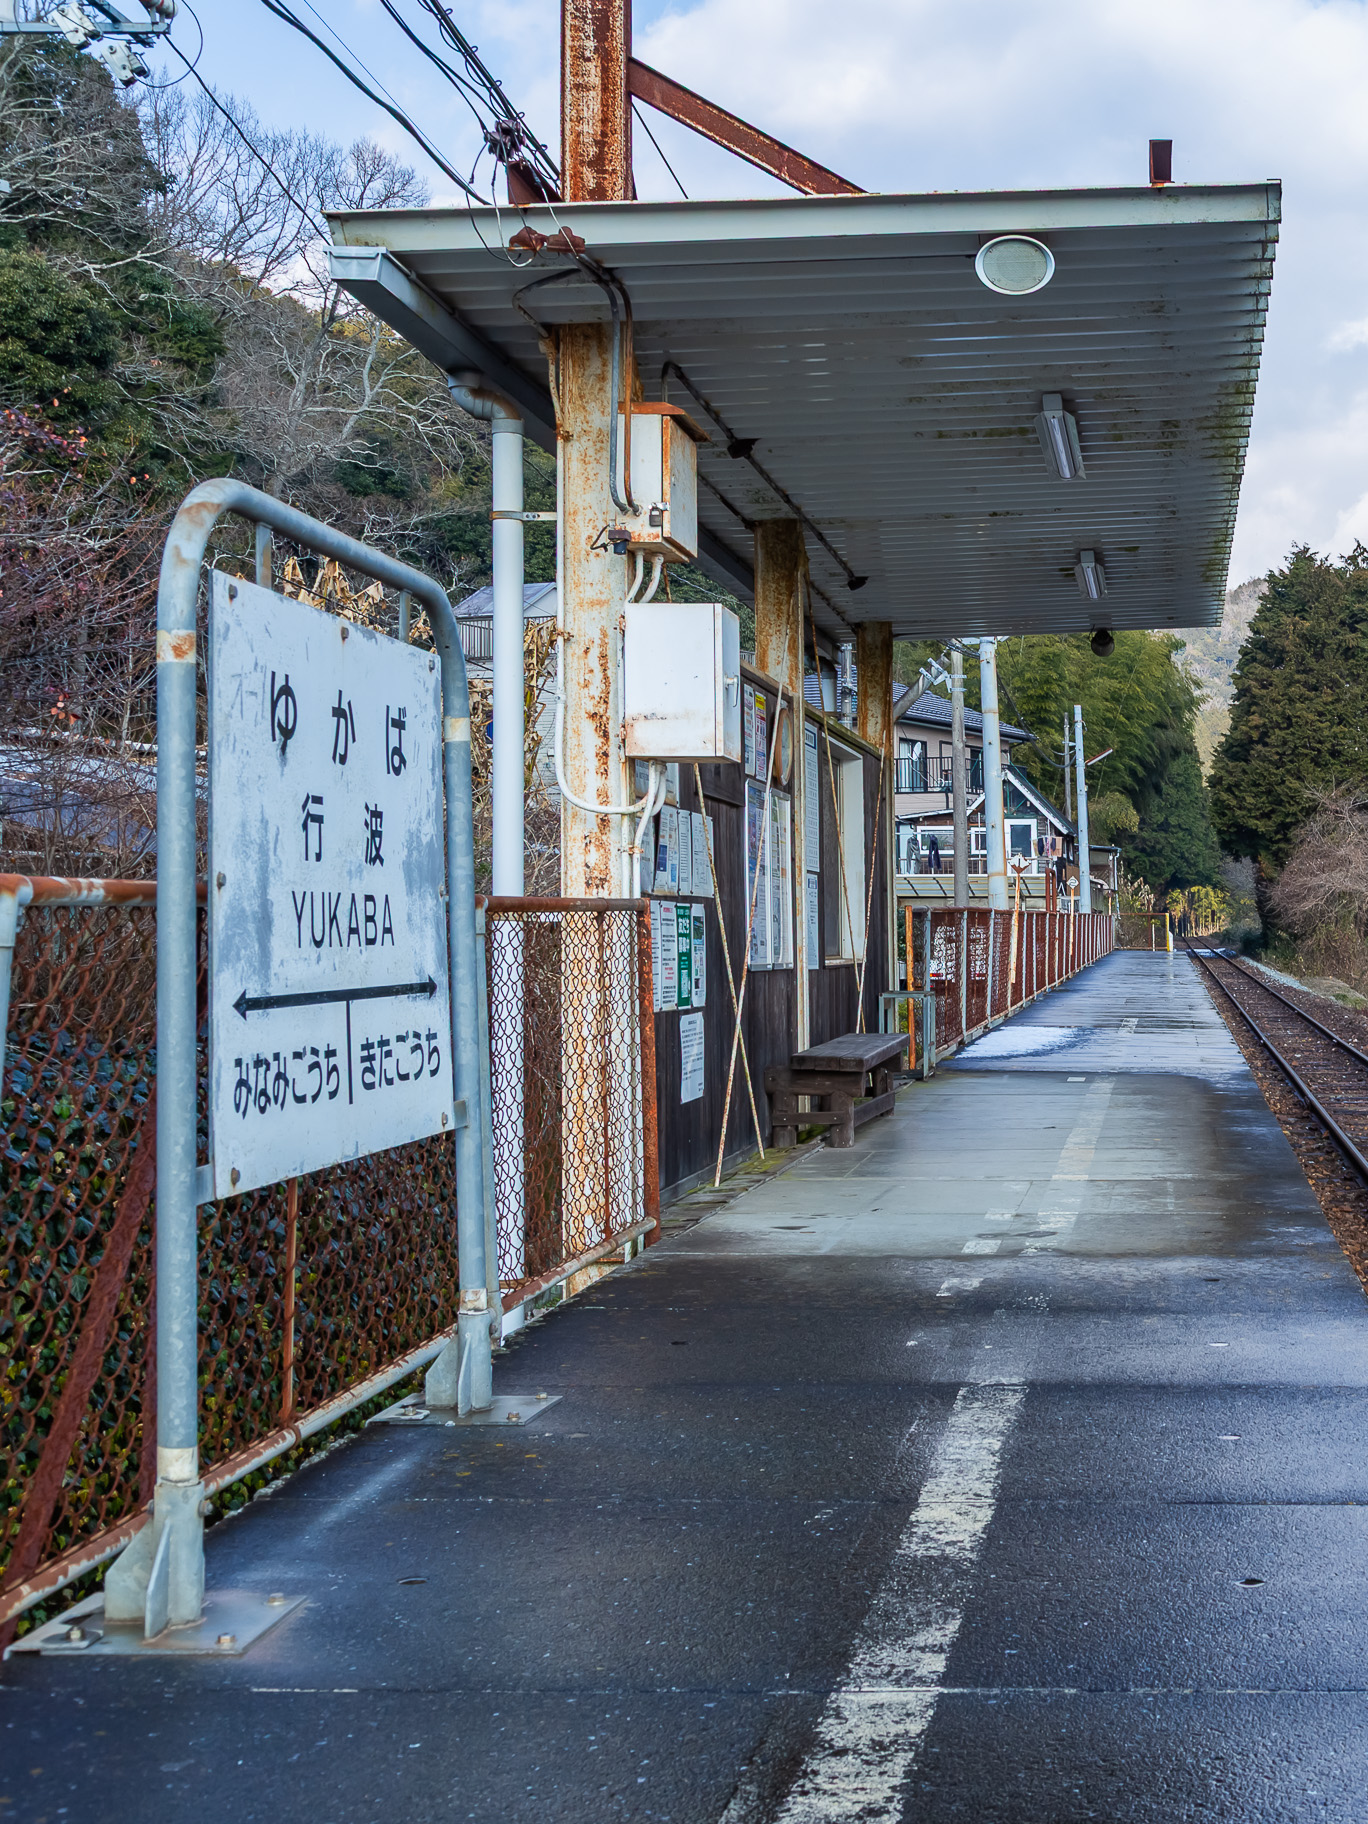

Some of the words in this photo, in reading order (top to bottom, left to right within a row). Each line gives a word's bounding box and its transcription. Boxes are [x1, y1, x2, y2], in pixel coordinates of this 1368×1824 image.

[270, 670, 408, 777] ゆかば
[301, 791, 385, 868] 行波
[291, 890, 396, 949] YUKABA
[233, 1043, 340, 1120] みなみごうち
[360, 1027, 441, 1091] きたごうち
